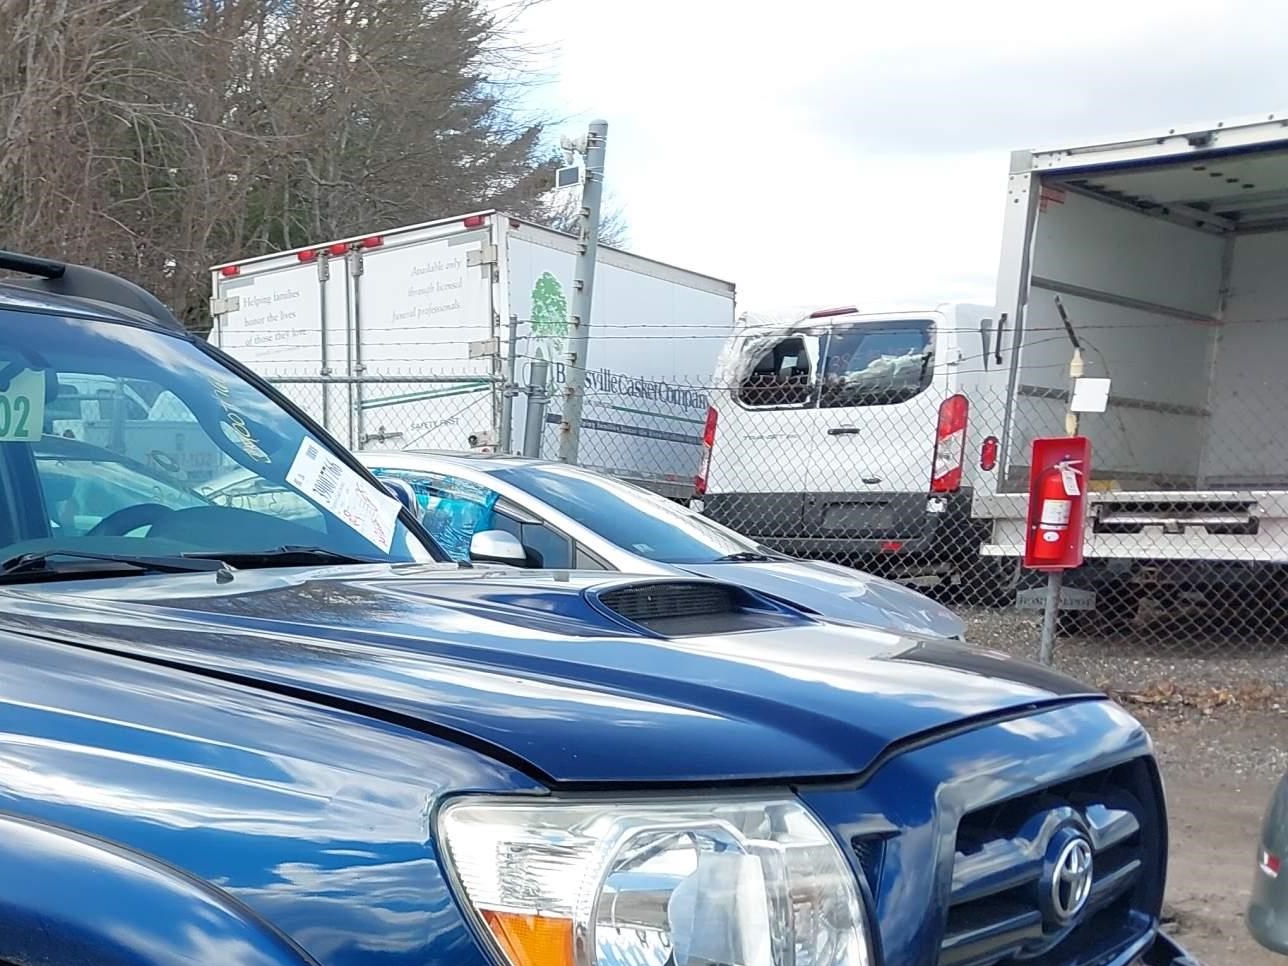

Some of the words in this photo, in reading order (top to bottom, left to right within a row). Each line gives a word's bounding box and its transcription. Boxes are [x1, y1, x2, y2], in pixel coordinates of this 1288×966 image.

[243, 294, 272, 308] Helping
[273, 288, 300, 302] families
[266, 311, 279, 323] the
[280, 309, 297, 321] lives
[254, 333, 273, 345] those
[312, 457, 344, 503] 39007766
